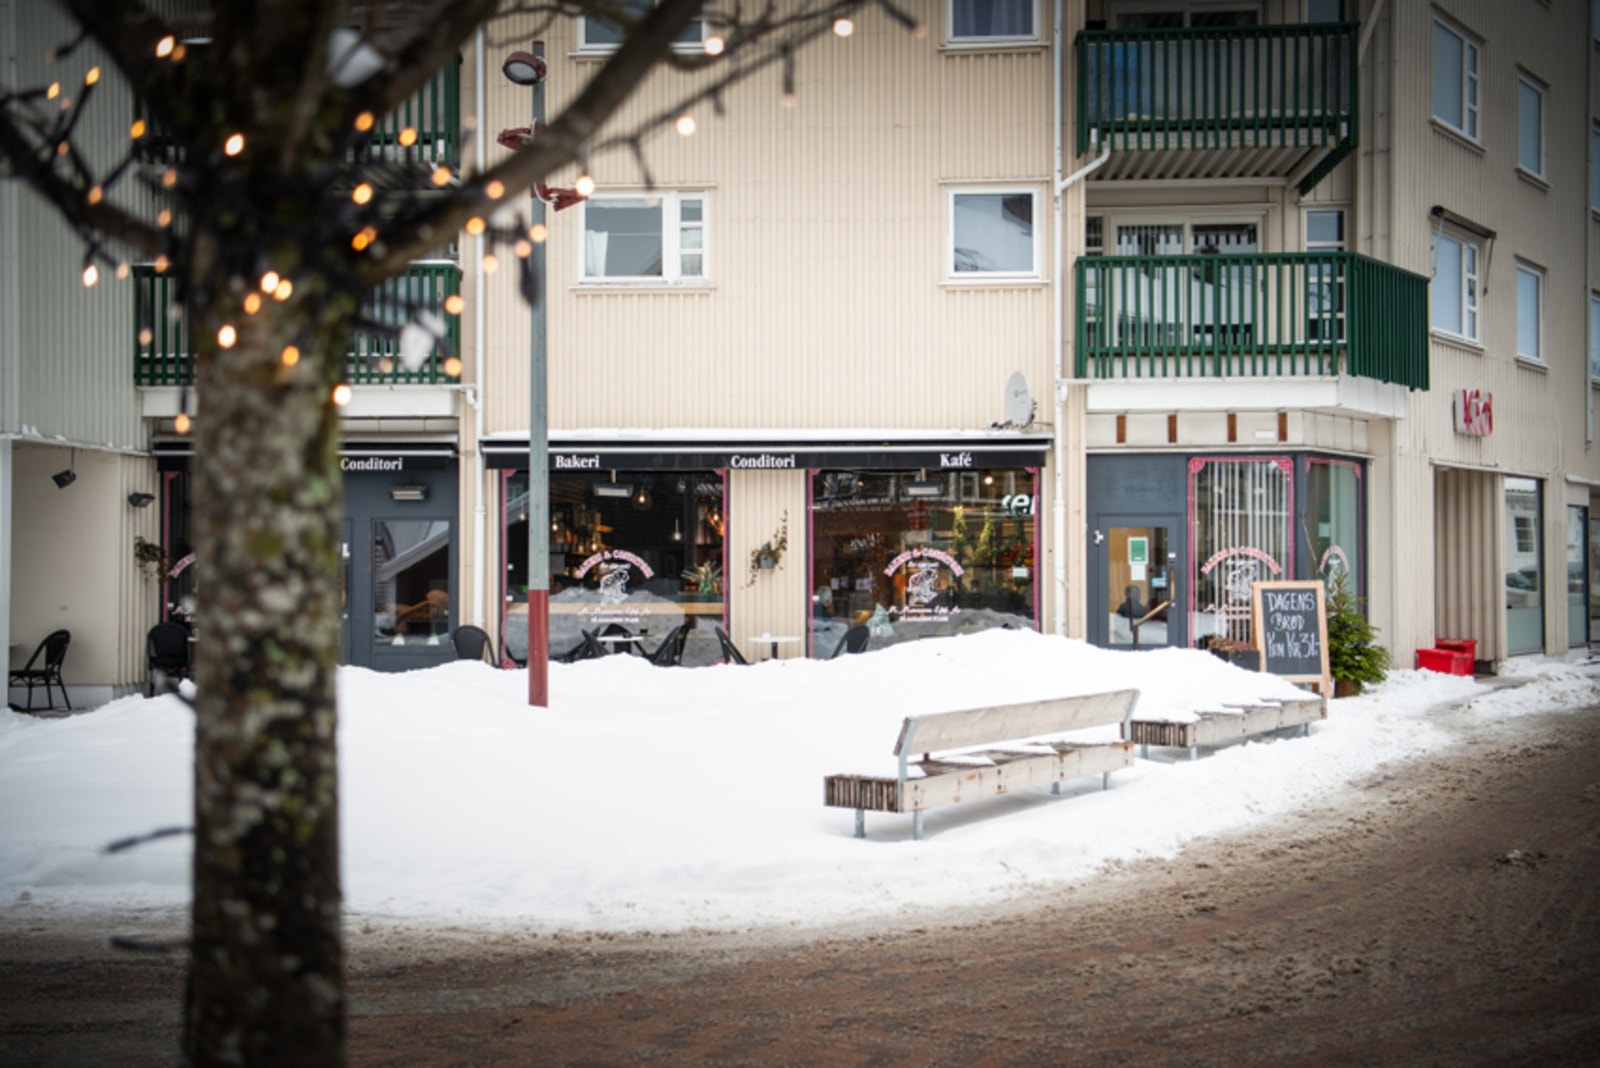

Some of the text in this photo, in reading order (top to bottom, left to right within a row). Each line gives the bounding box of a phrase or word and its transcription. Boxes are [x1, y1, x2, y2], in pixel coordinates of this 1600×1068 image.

[340, 457, 403, 471] Conditori
[555, 452, 972, 469] Bakeri Conditori Kafé
[1265, 592, 1315, 612] DAGENS
